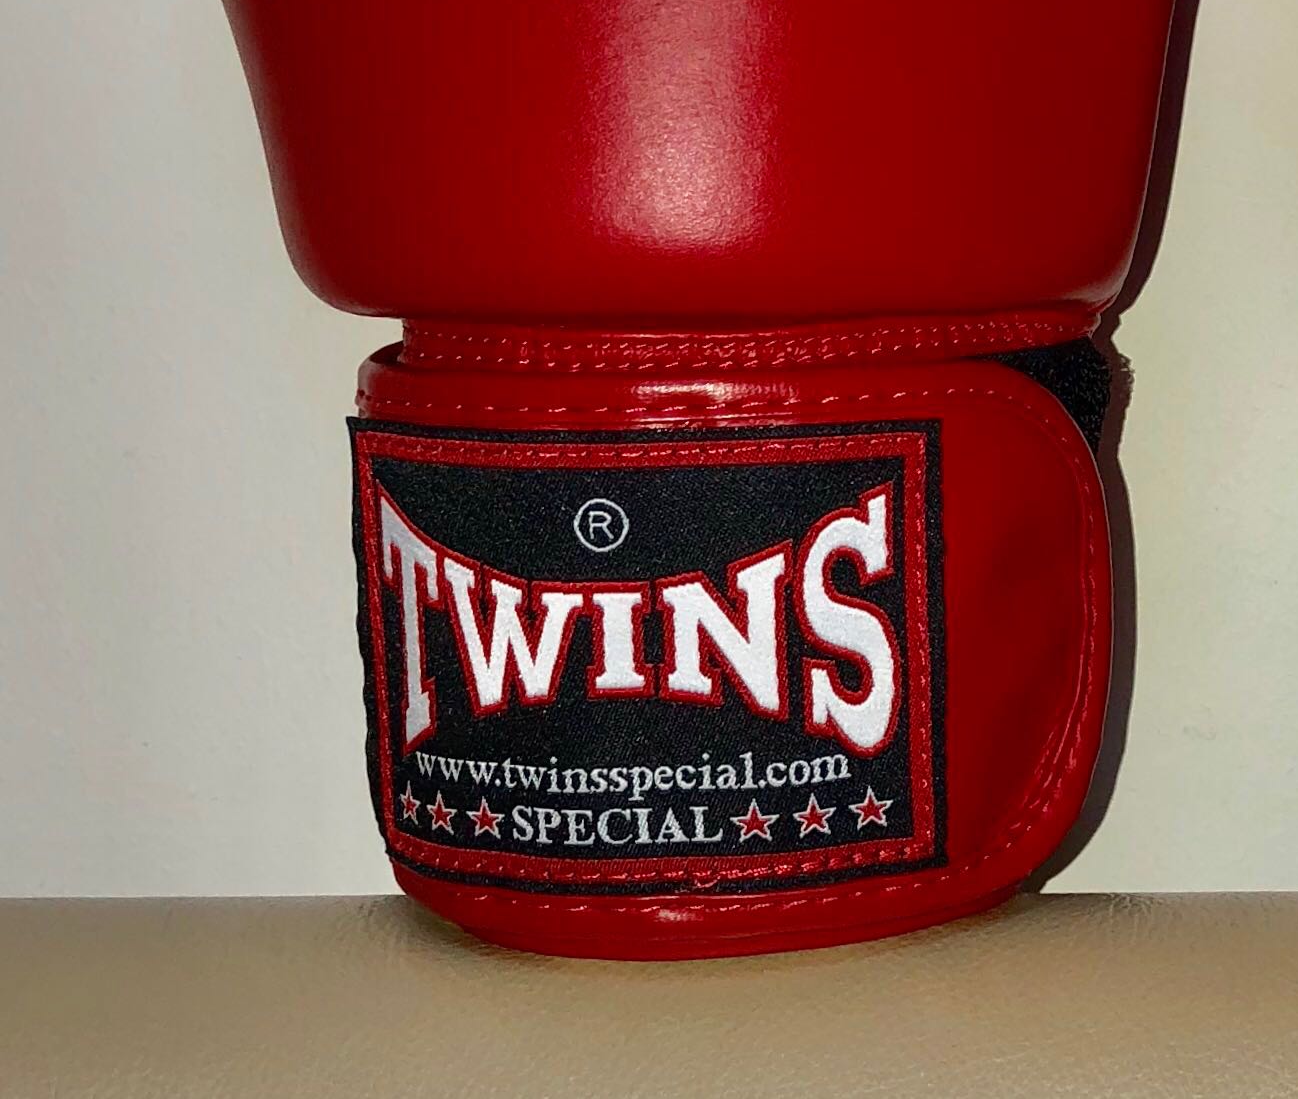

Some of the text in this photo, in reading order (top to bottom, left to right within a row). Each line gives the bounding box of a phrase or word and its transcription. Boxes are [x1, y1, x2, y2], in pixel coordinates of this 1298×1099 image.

[376, 480, 900, 757] TWINS
[415, 750, 853, 800] www.twinsspecial.com
[512, 805, 723, 846] SPECIAL
